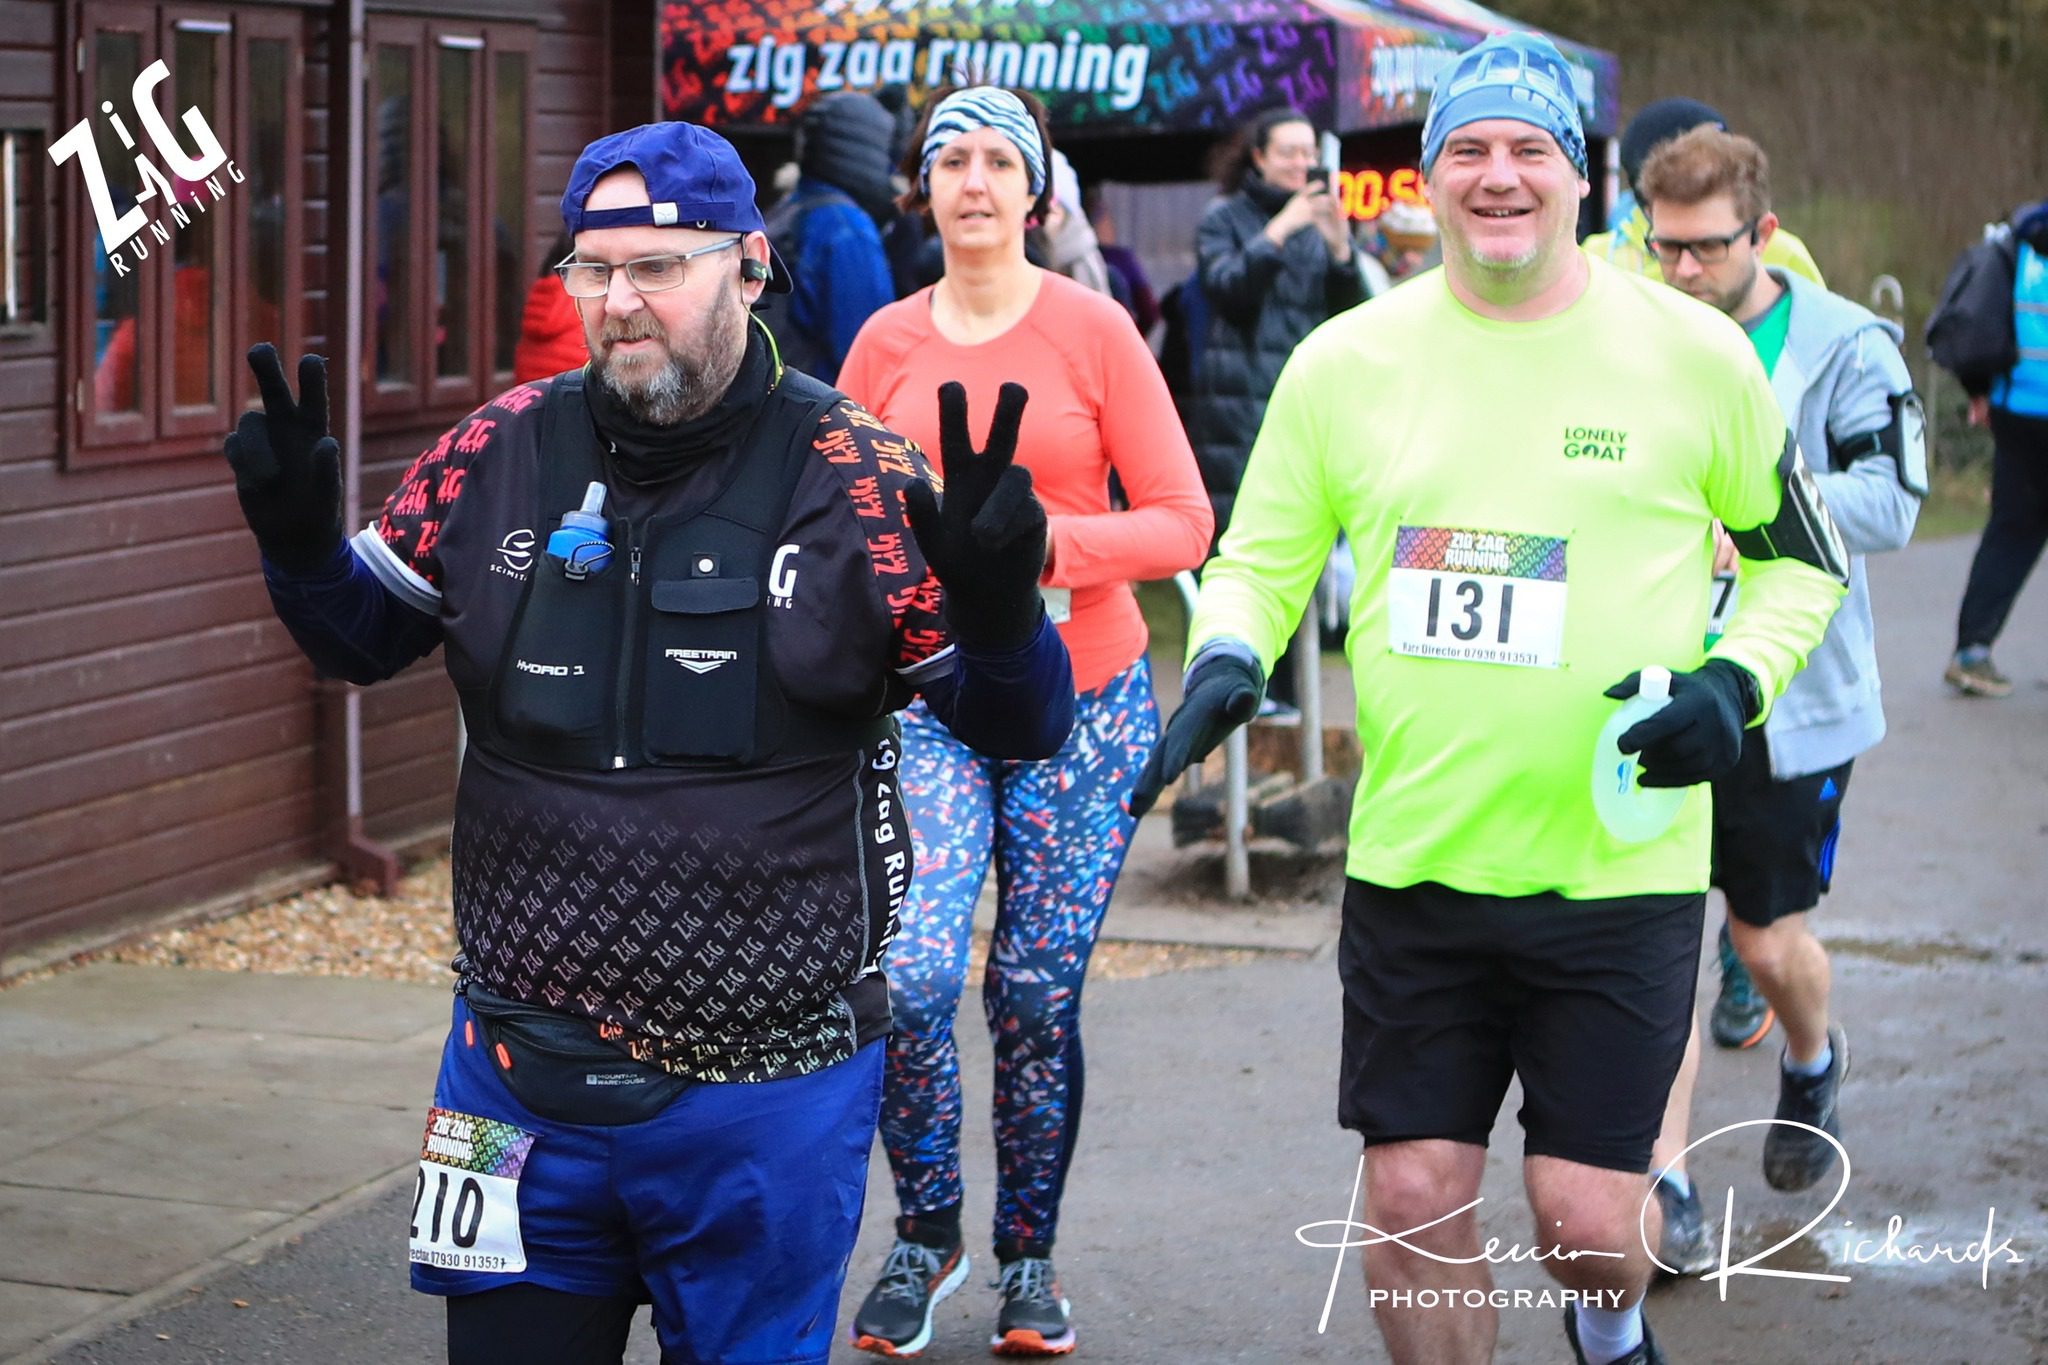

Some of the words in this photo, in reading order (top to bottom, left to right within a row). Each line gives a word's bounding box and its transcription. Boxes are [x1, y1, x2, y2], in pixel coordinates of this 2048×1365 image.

[725, 35, 806, 108] zig
[926, 29, 1149, 110] running
[1564, 427, 1627, 443] LONELY
[1564, 443, 1626, 462] GOAT
[1444, 548, 1510, 573] RUNNING
[1426, 578, 1514, 643] 131
[665, 649, 737, 661] FREETRAIN
[1421, 645, 1461, 658] Director
[1464, 648, 1497, 660] 07930
[1499, 650, 1539, 665] 913531
[516, 659, 569, 676] HYDRO
[572, 665, 585, 676] 1
[426, 1136, 474, 1161] RUNNING
